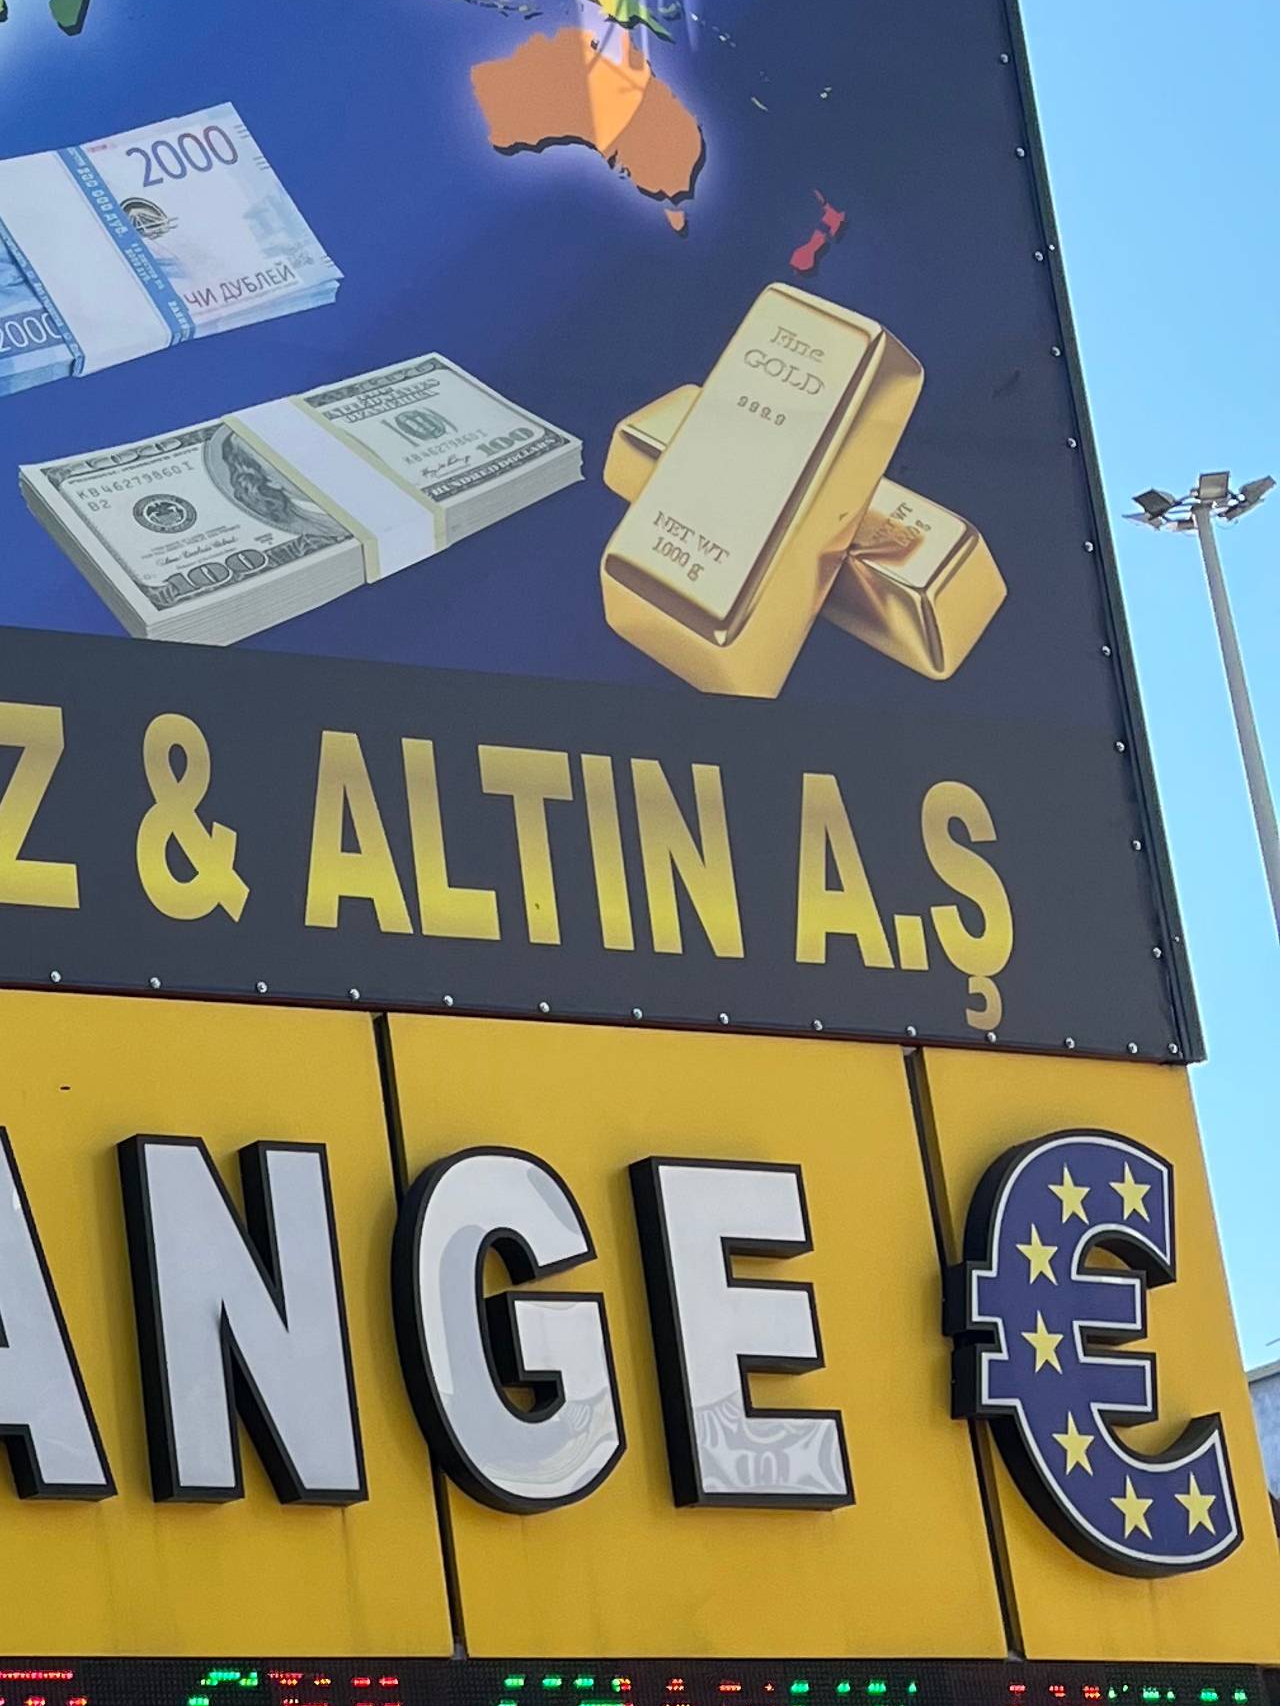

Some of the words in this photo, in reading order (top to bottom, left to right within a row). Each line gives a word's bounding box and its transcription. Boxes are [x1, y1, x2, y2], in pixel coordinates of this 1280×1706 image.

[126, 125, 238, 187] 2000
[220, 262, 295, 302] ДУБЛЕЙ
[770, 325, 826, 364] Fine
[743, 349, 826, 396] GOLD
[737, 394, 786, 427] 999.9
[476, 427, 535, 457] 100
[650, 536, 691, 569] 1000
[654, 511, 697, 545] NET
[696, 532, 731, 566] WT
[137, 713, 249, 922] &
[304, 731, 744, 960] ALTIN
[795, 773, 1014, 1031] A.Ş
